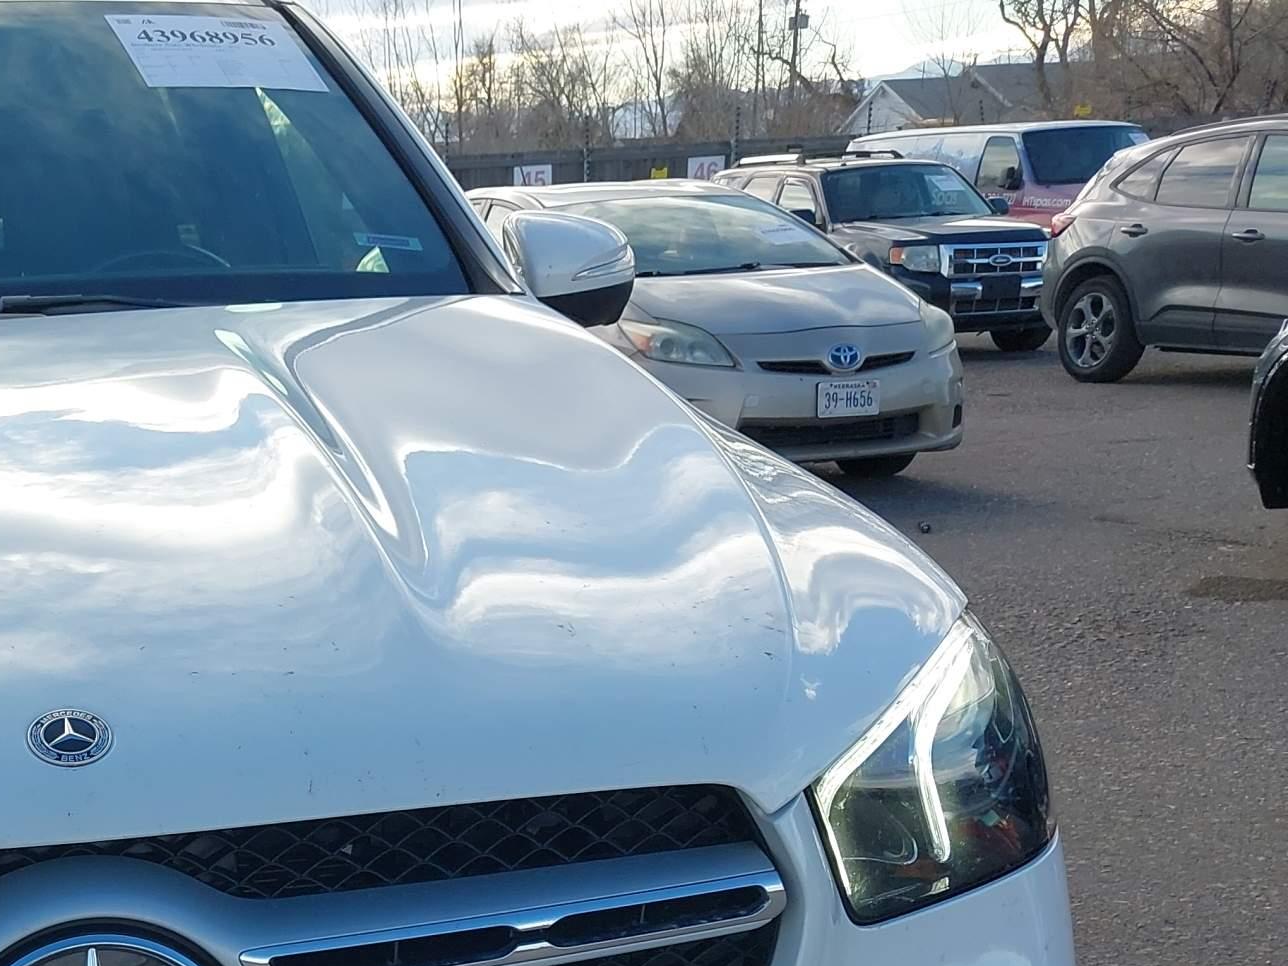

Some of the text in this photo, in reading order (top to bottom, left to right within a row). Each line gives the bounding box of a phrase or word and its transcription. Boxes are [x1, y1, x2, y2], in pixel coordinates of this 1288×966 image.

[137, 29, 275, 47] 43968956
[824, 391, 873, 409] 39-H656
[39, 709, 93, 724] MERCEDES
[60, 753, 91, 762] BENZ
